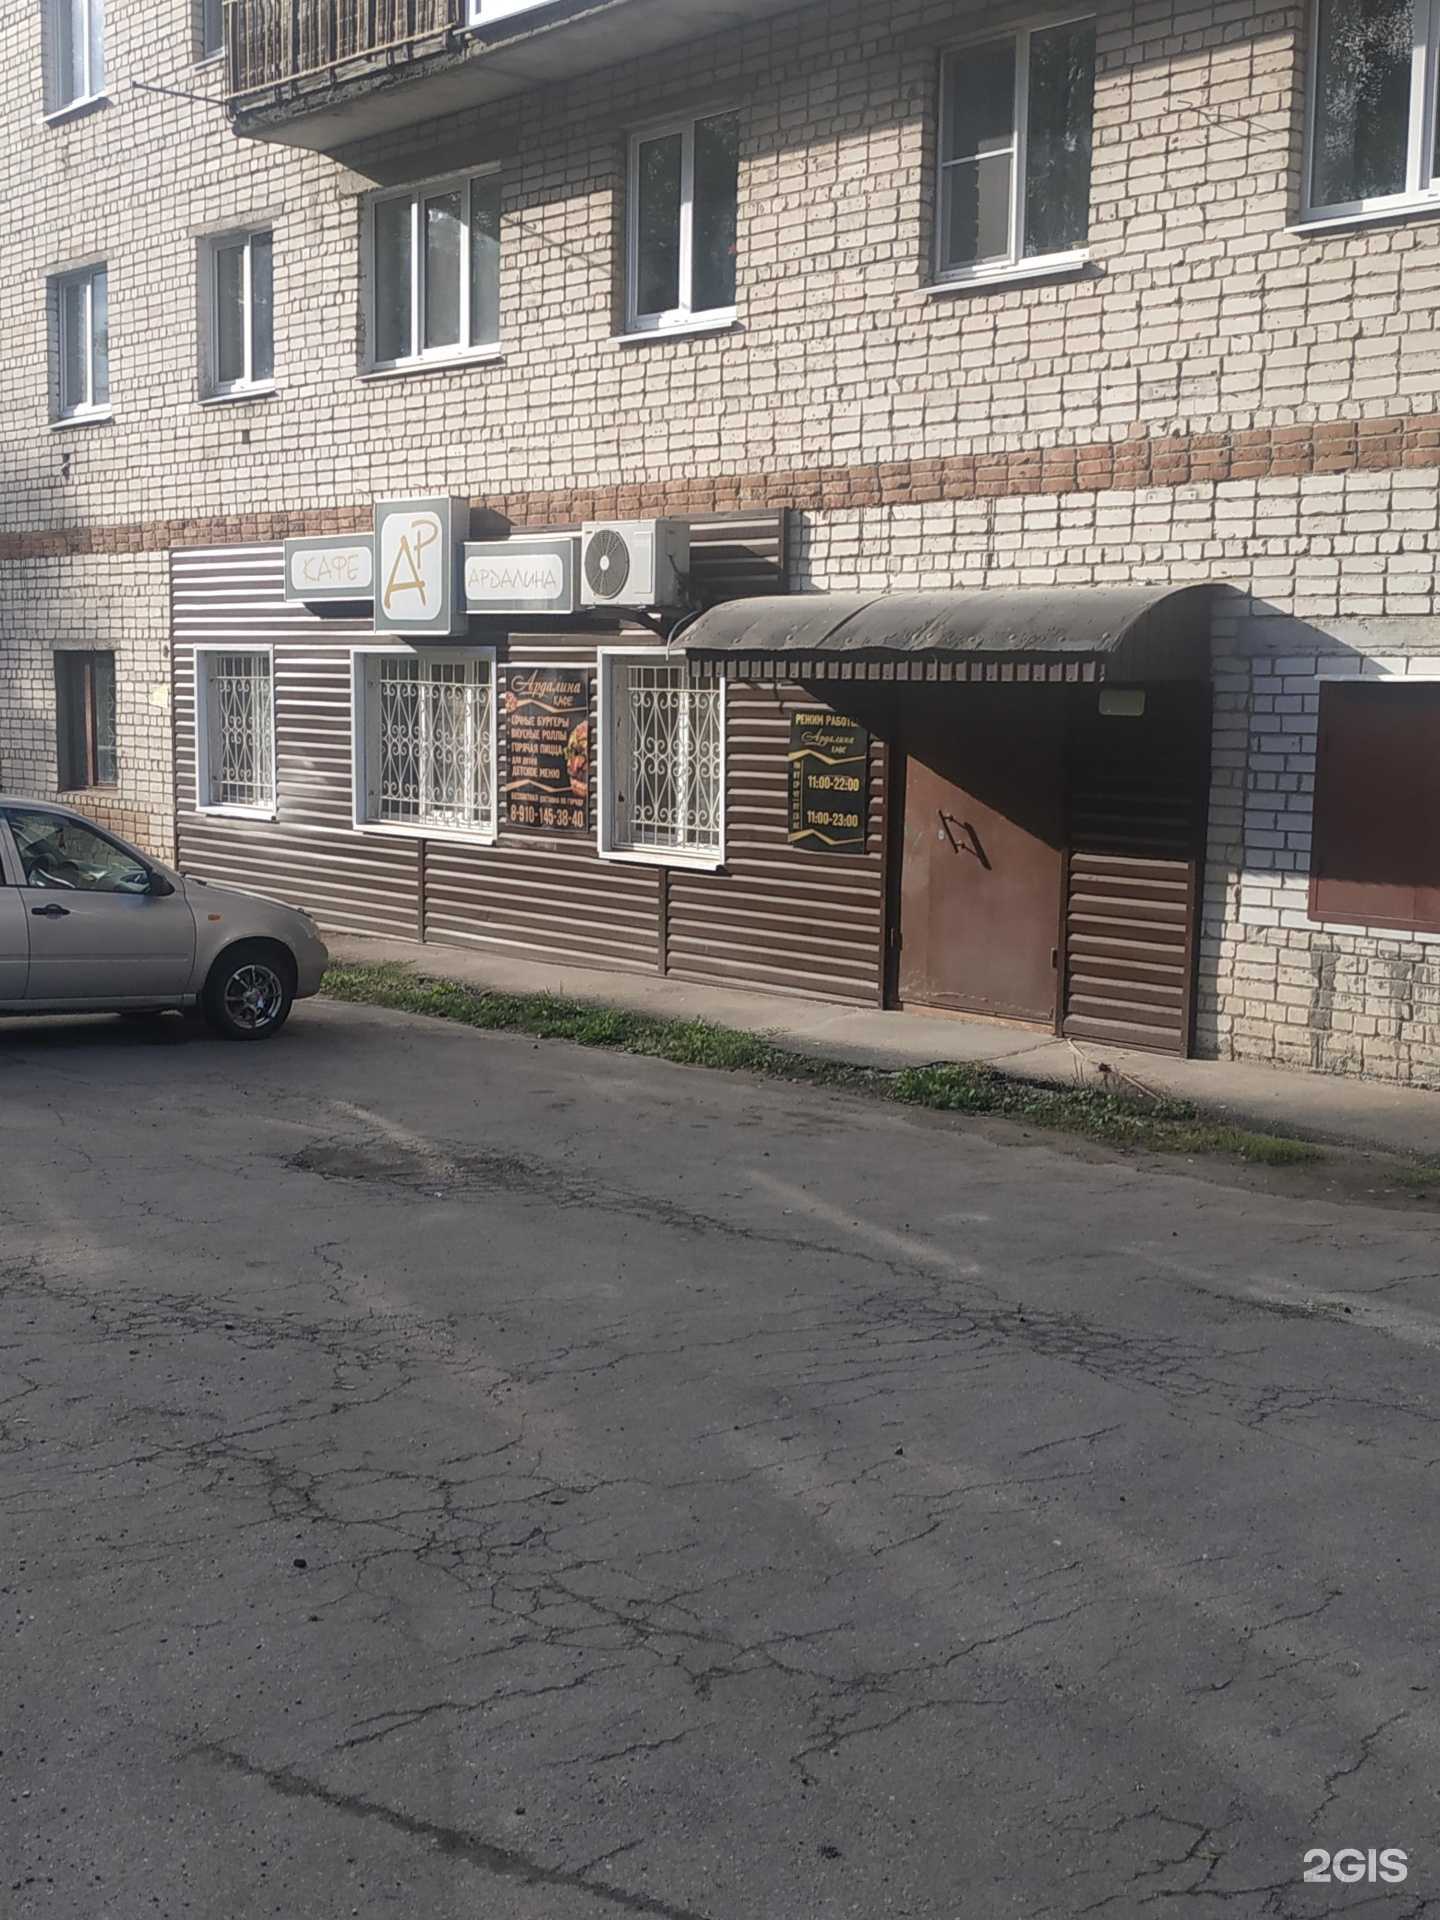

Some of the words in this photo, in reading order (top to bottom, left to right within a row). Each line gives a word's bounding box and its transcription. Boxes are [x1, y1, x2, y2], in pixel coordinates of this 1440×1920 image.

[302, 554, 359, 583] КАФЕ
[467, 568, 557, 589] АРДАЛИНА
[511, 669, 581, 698] Ардалина
[537, 716, 570, 728] БУРГЕРЫ
[796, 713, 824, 726] РЕЖИМ
[542, 729, 568, 741] РОЛЛЫ
[540, 743, 563, 756] ПИЦЦА
[539, 767, 560, 779] МЕНЮ
[807, 775, 860, 792] 11:00-22:00
[806, 810, 859, 828] 11:00-23:00
